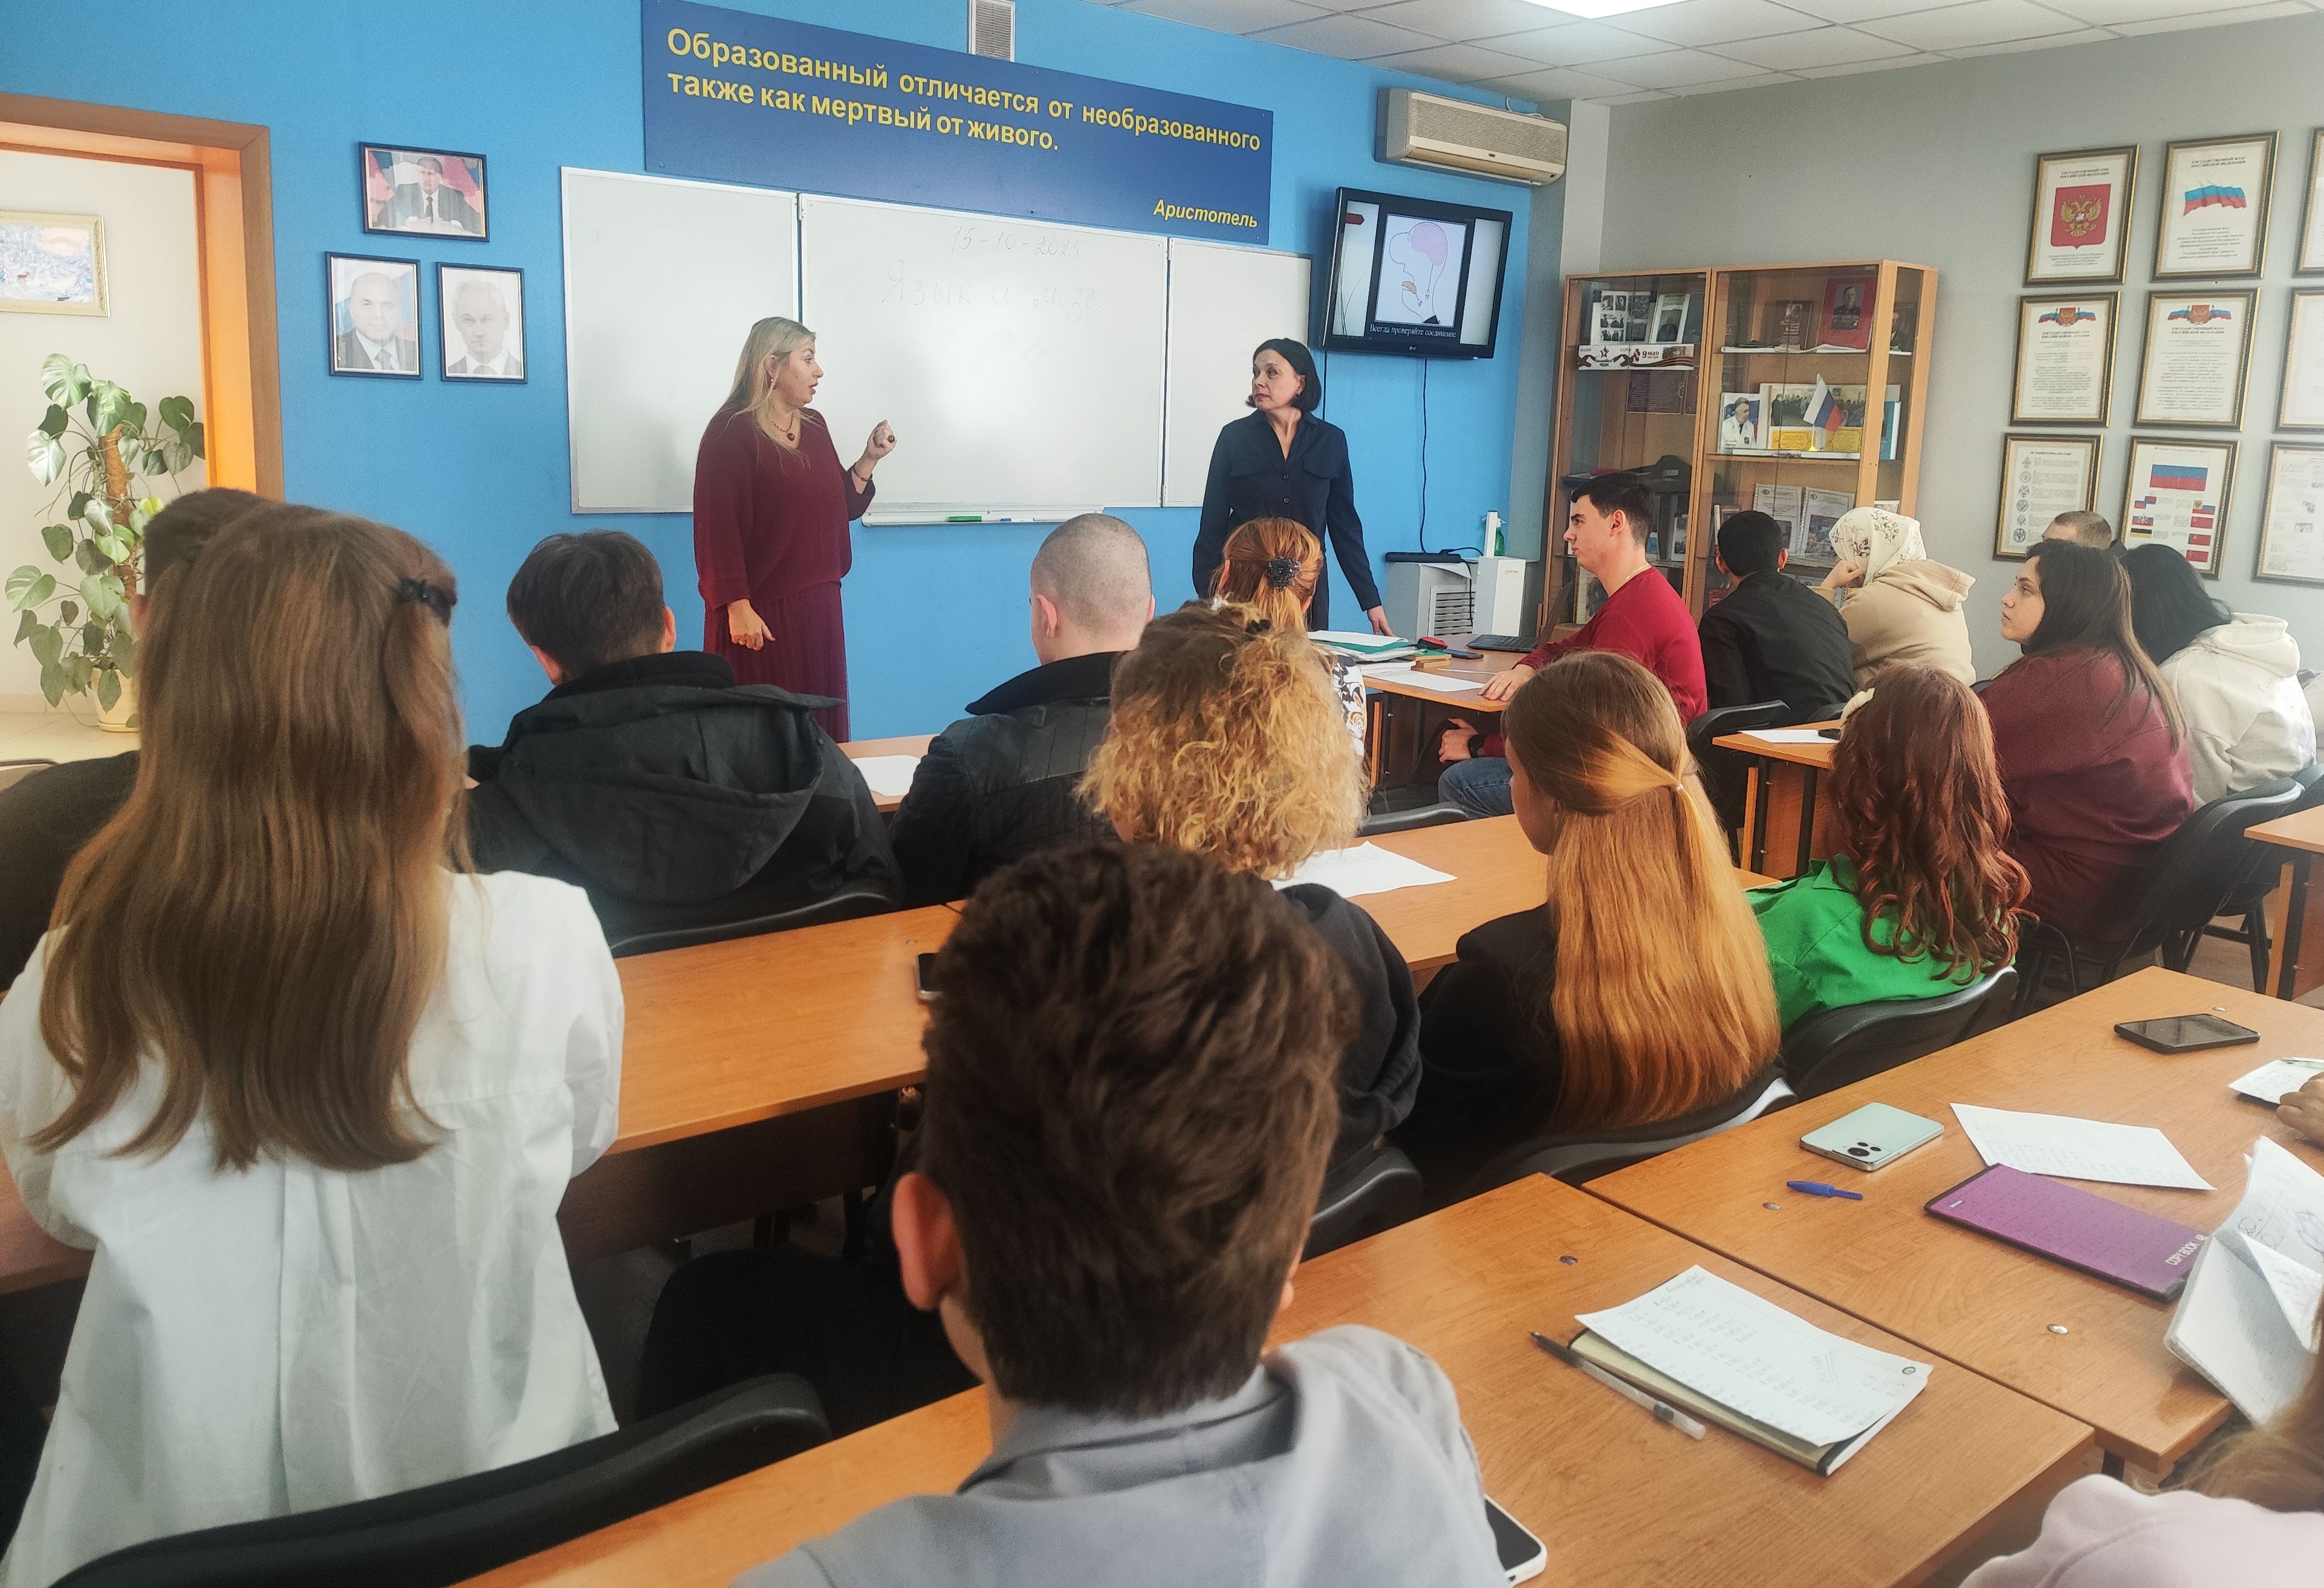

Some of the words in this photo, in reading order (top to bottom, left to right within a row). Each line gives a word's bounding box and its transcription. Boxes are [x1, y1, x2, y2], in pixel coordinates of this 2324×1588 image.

[667, 73, 754, 104] также
[761, 88, 805, 112] как
[811, 96, 930, 130] мертвый
[936, 115, 963, 135] от
[967, 120, 1059, 151] живого.
[668, 28, 888, 88] Образованный
[899, 74, 1039, 114] отличается
[1048, 100, 1073, 118] от
[1083, 106, 1260, 151] необразованного
[1154, 199, 1257, 228] Аристотель
[881, 259, 972, 306] Язык
[1369, 323, 1390, 333] Всегда
[1391, 327, 1424, 337] проверяйте
